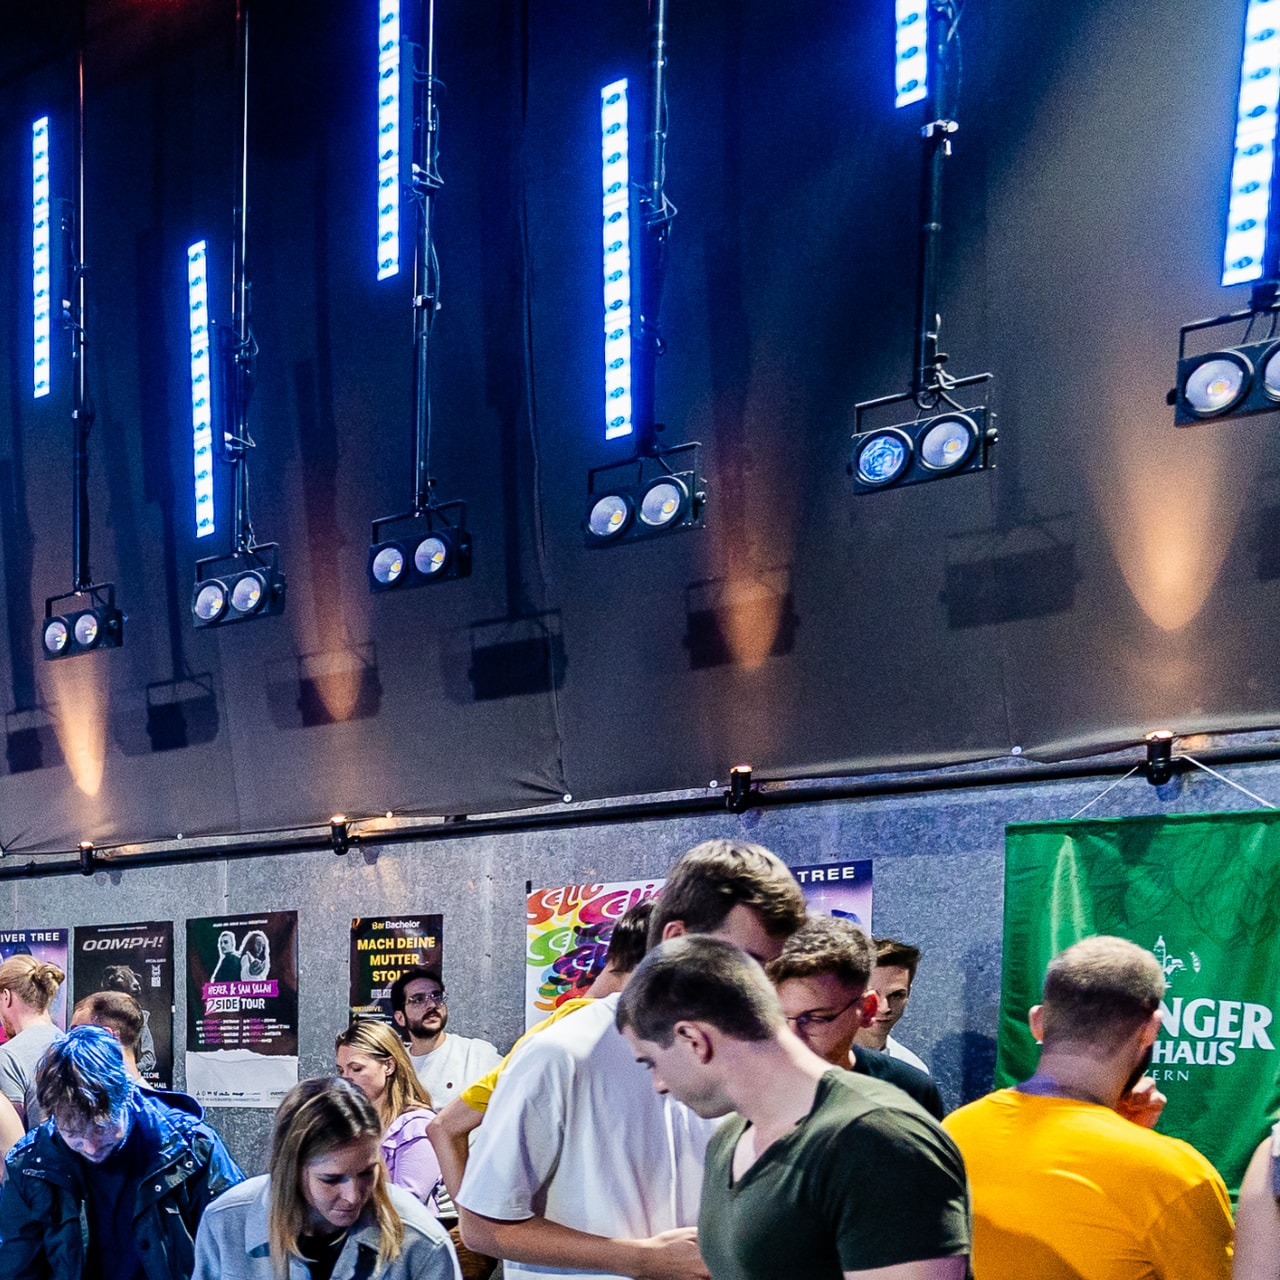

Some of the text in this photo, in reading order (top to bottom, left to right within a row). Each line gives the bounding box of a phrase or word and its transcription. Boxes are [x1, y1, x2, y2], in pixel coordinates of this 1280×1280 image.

[797, 866, 855, 883] TREE
[30, 932, 60, 942] TREE
[82, 936, 165, 951] OOMPH!
[357, 936, 436, 950] MACH DEINE
[370, 954, 420, 966] MUTTER
[372, 969, 410, 982] STOL
[241, 998, 266, 1010] TOUR
[1158, 997, 1276, 1050] NGER
[1152, 1040, 1236, 1066] HAUS
[1146, 1069, 1190, 1081] ERN
